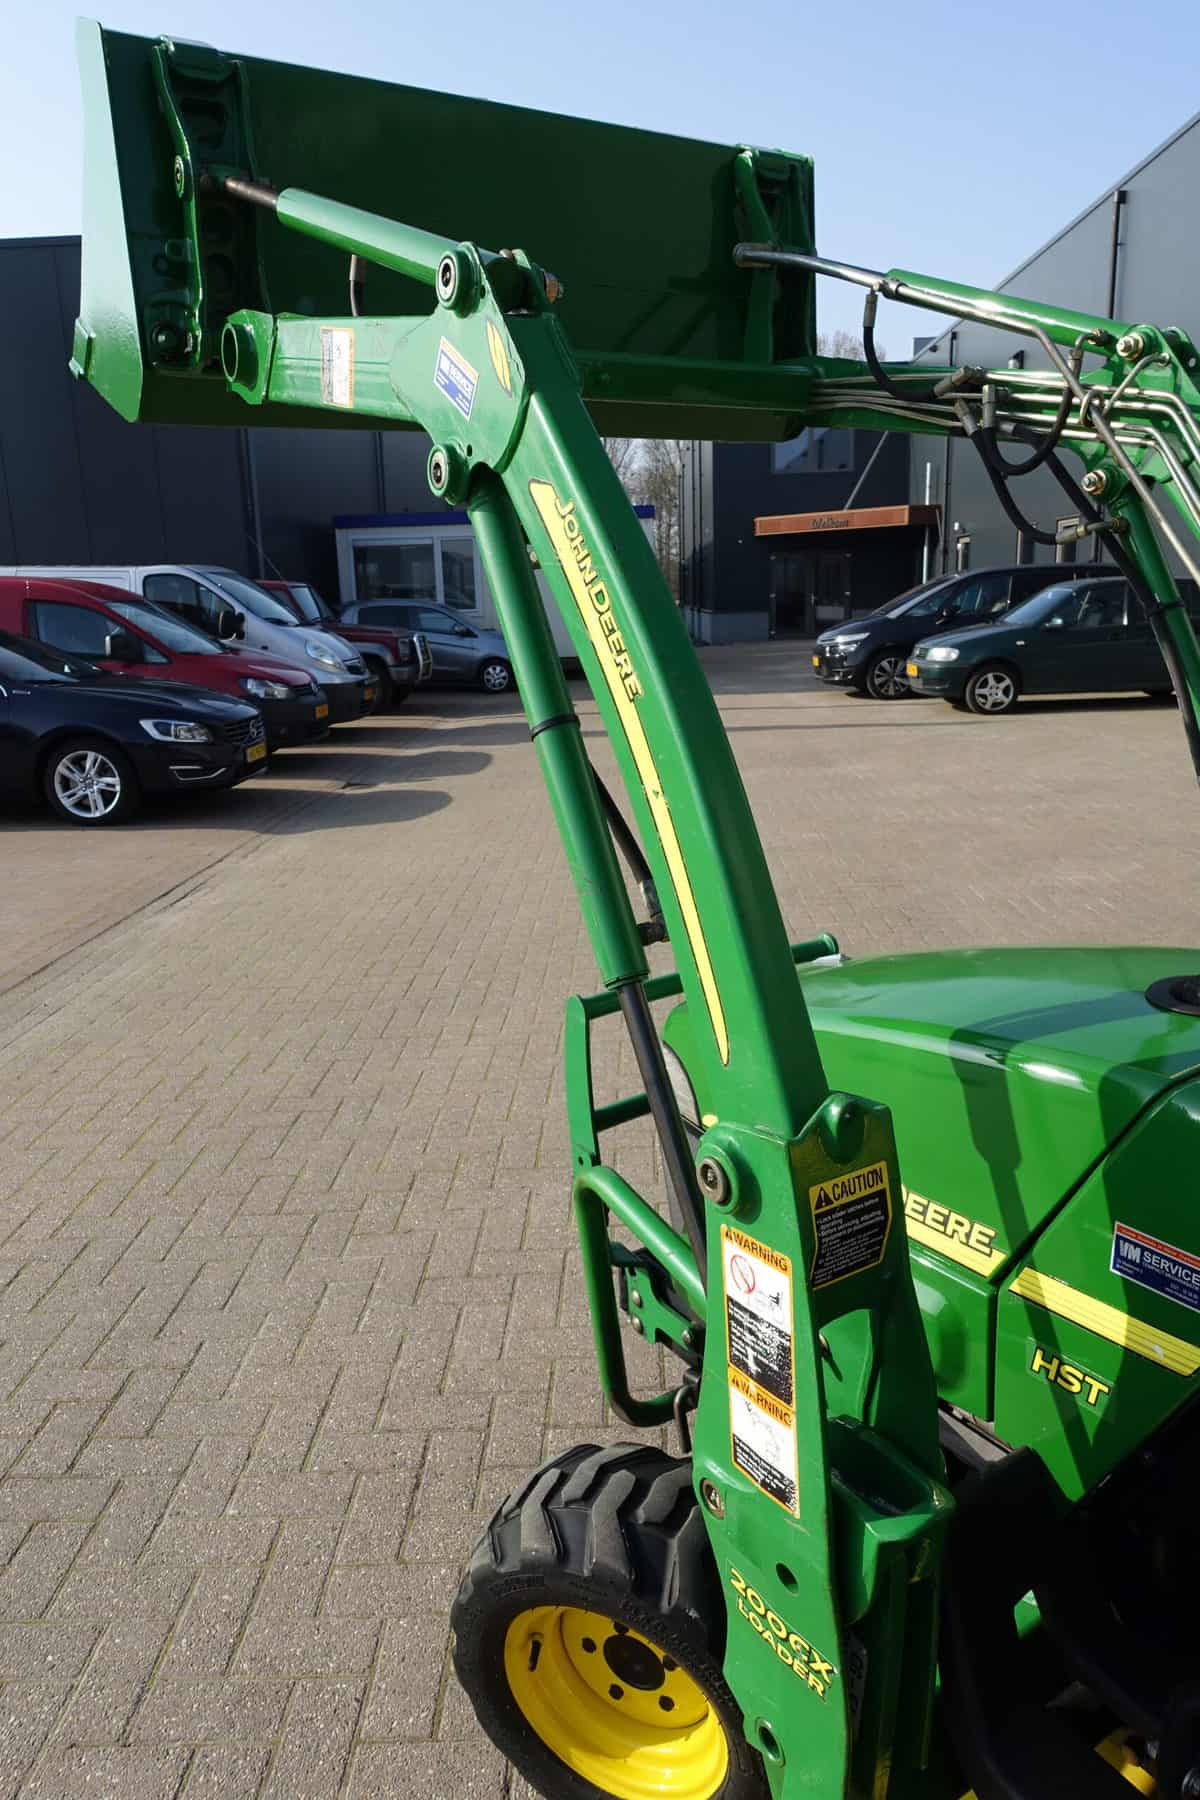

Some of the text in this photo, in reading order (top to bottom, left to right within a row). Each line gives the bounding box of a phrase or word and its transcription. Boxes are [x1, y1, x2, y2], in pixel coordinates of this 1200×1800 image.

[554, 496, 643, 703] JOHN DEERE
[832, 1167, 884, 1201] CAUTION
[733, 1230, 788, 1272] WARNING
[901, 1183, 997, 1257] EERE
[1142, 1251, 1200, 1286] SERVICE
[1031, 1348, 1110, 1405] HST
[729, 1567, 834, 1685] 200CX
[737, 1596, 825, 1698] LOADER
